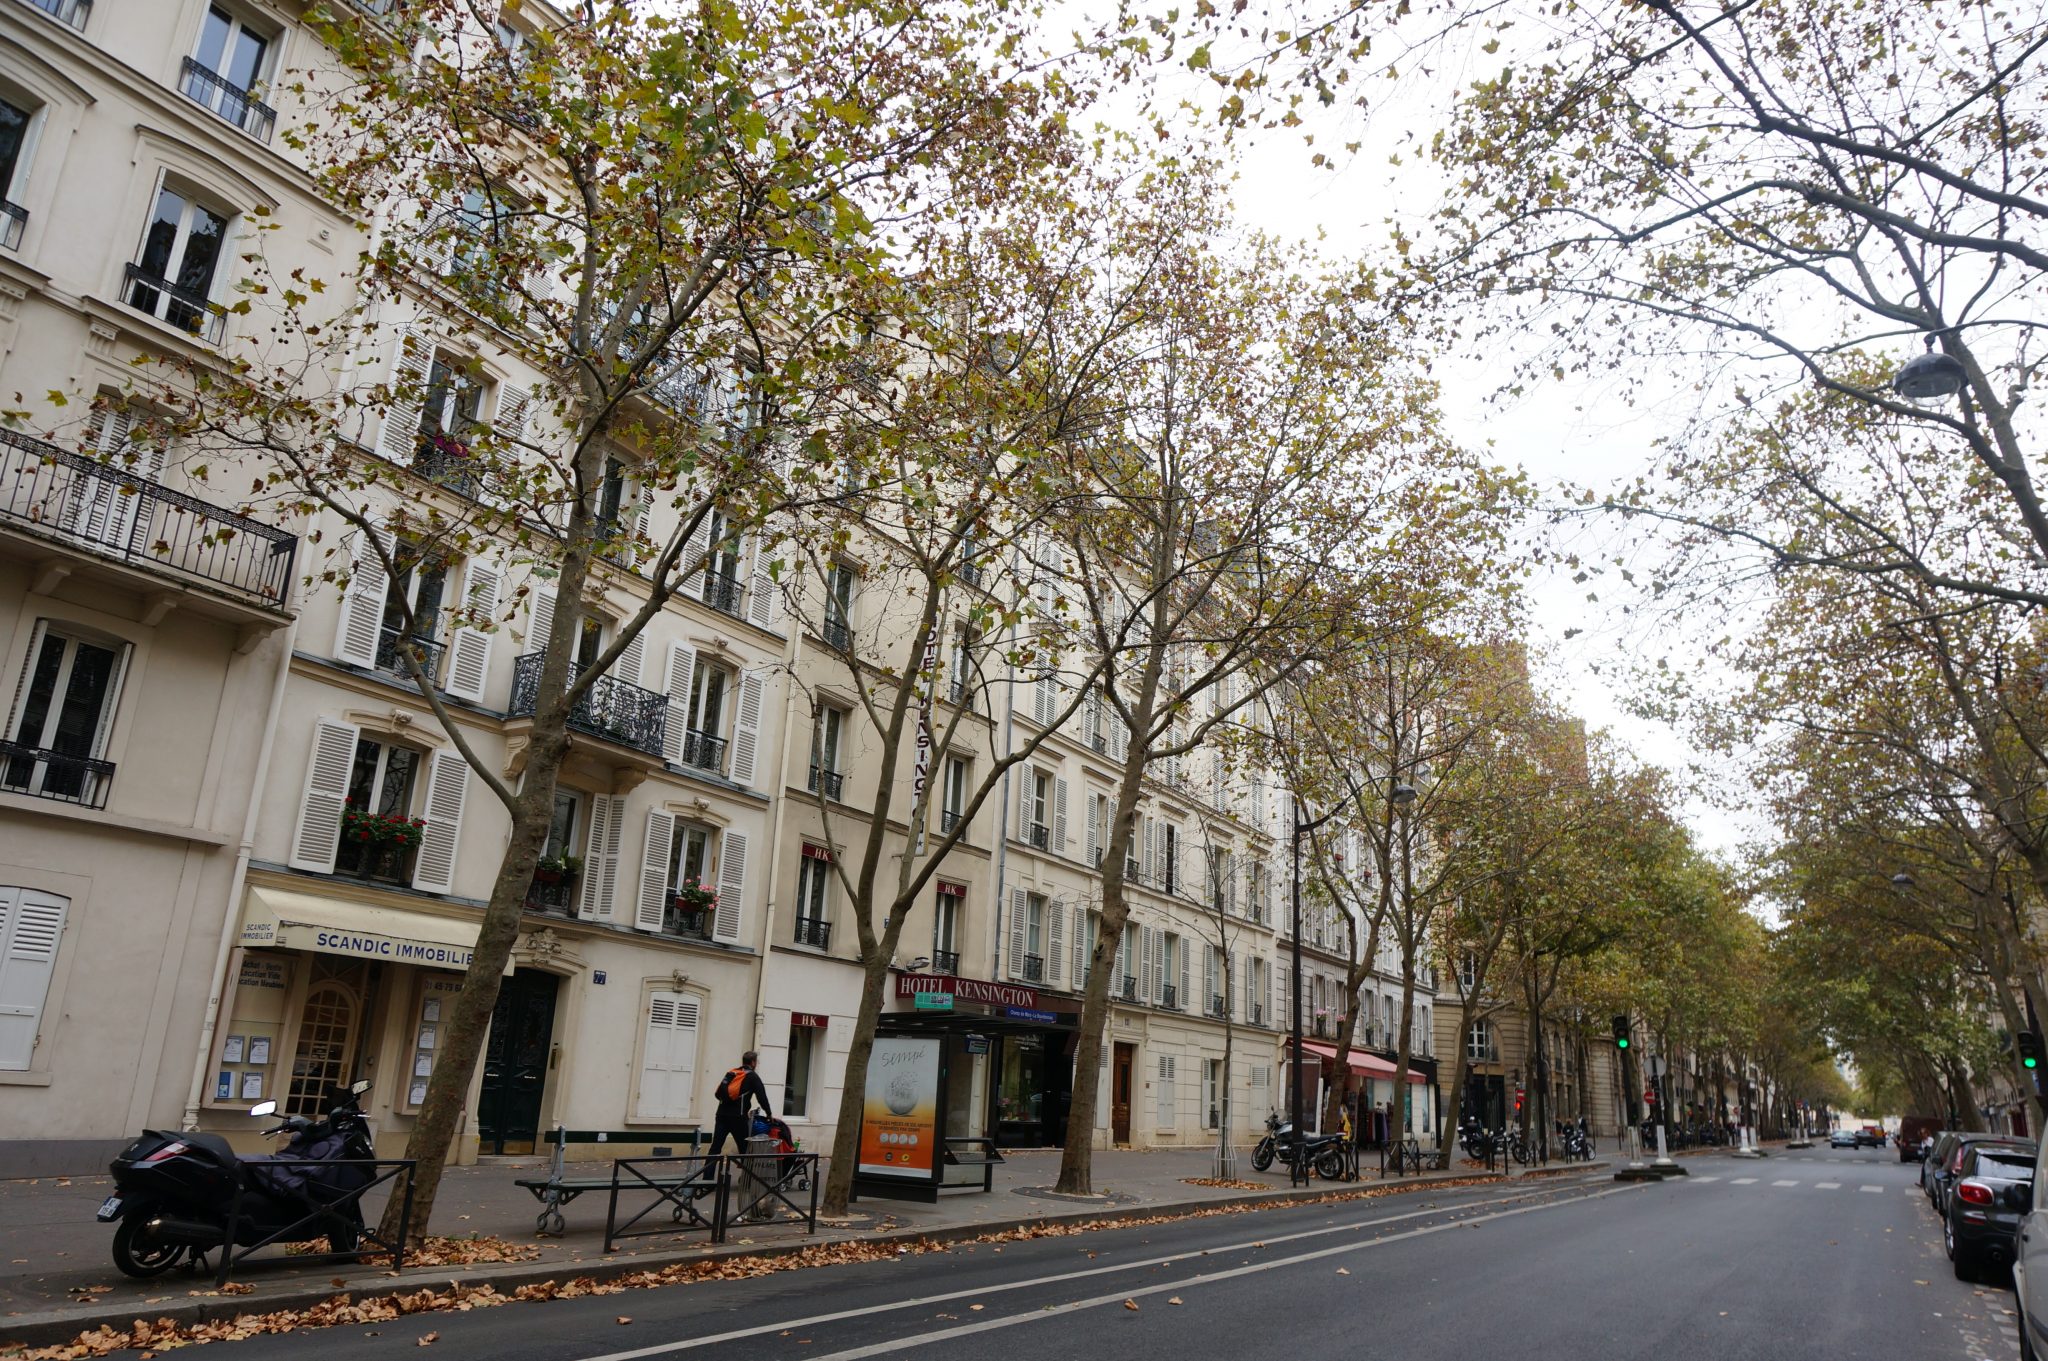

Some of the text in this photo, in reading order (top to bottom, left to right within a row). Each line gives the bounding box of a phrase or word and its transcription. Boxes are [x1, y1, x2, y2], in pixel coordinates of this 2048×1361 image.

[814, 847, 830, 861] HK
[944, 883, 957, 895] HK
[246, 923, 272, 931] SCANDIC
[240, 932, 274, 940] IMMOBILIER
[316, 932, 474, 966] SCANDIC IMMOBILIE
[237, 977, 260, 987] ocation
[901, 976, 947, 994] HOTEL
[955, 980, 1034, 1007] KENSINGTON
[802, 1014, 817, 1026] HK
